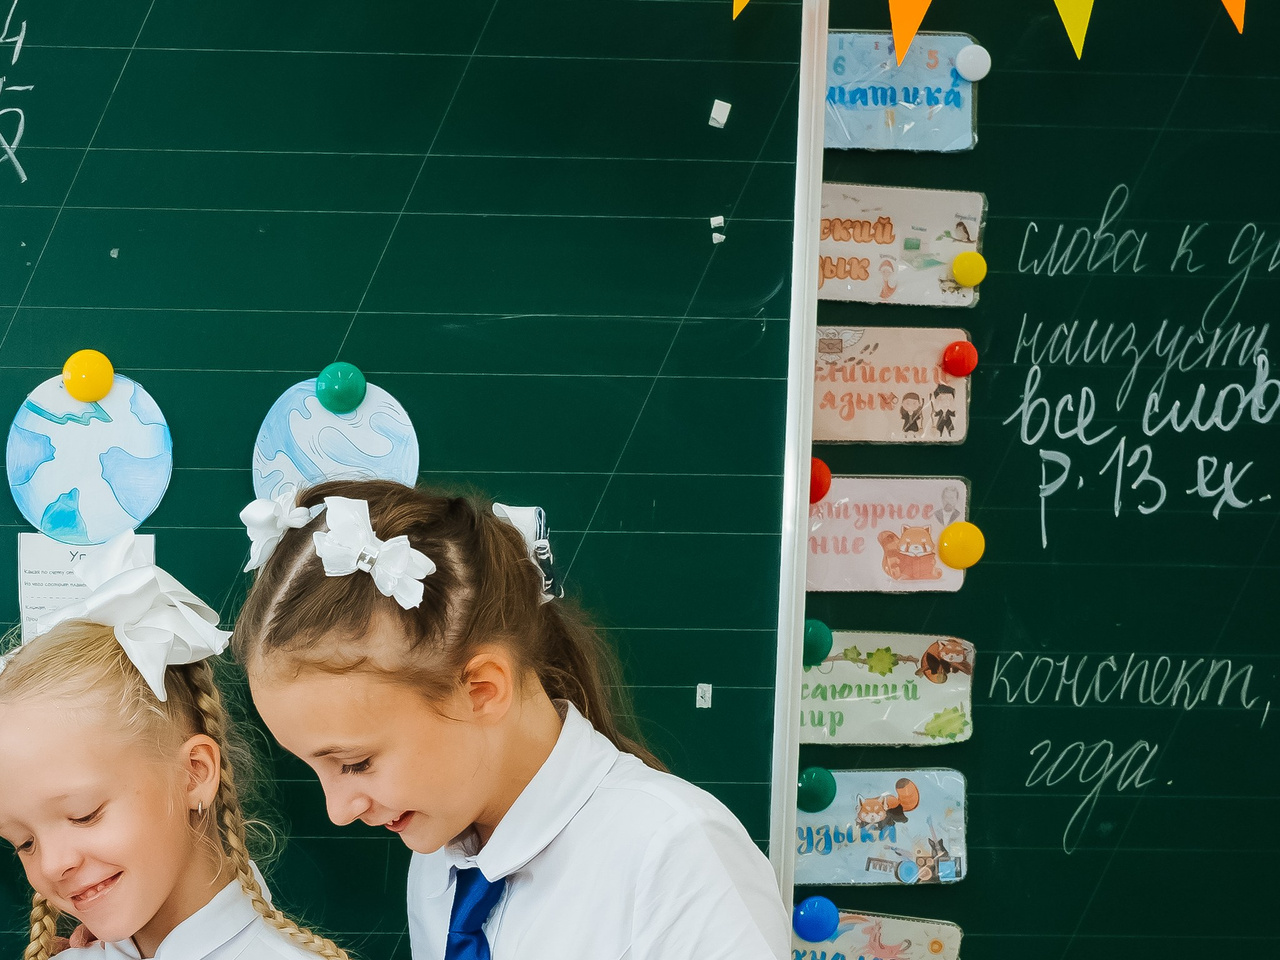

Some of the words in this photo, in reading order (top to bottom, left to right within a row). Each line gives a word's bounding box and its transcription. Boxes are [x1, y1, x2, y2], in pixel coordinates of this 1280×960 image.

[0, 0, 27, 65] 4
[1017, 183, 1148, 277] слова
[1170, 222, 1209, 273] к
[1002, 364, 1118, 446] все
[1099, 435, 1167, 518] 13
[988, 650, 1270, 729] конспект,
[1024, 739, 1174, 856] года.
